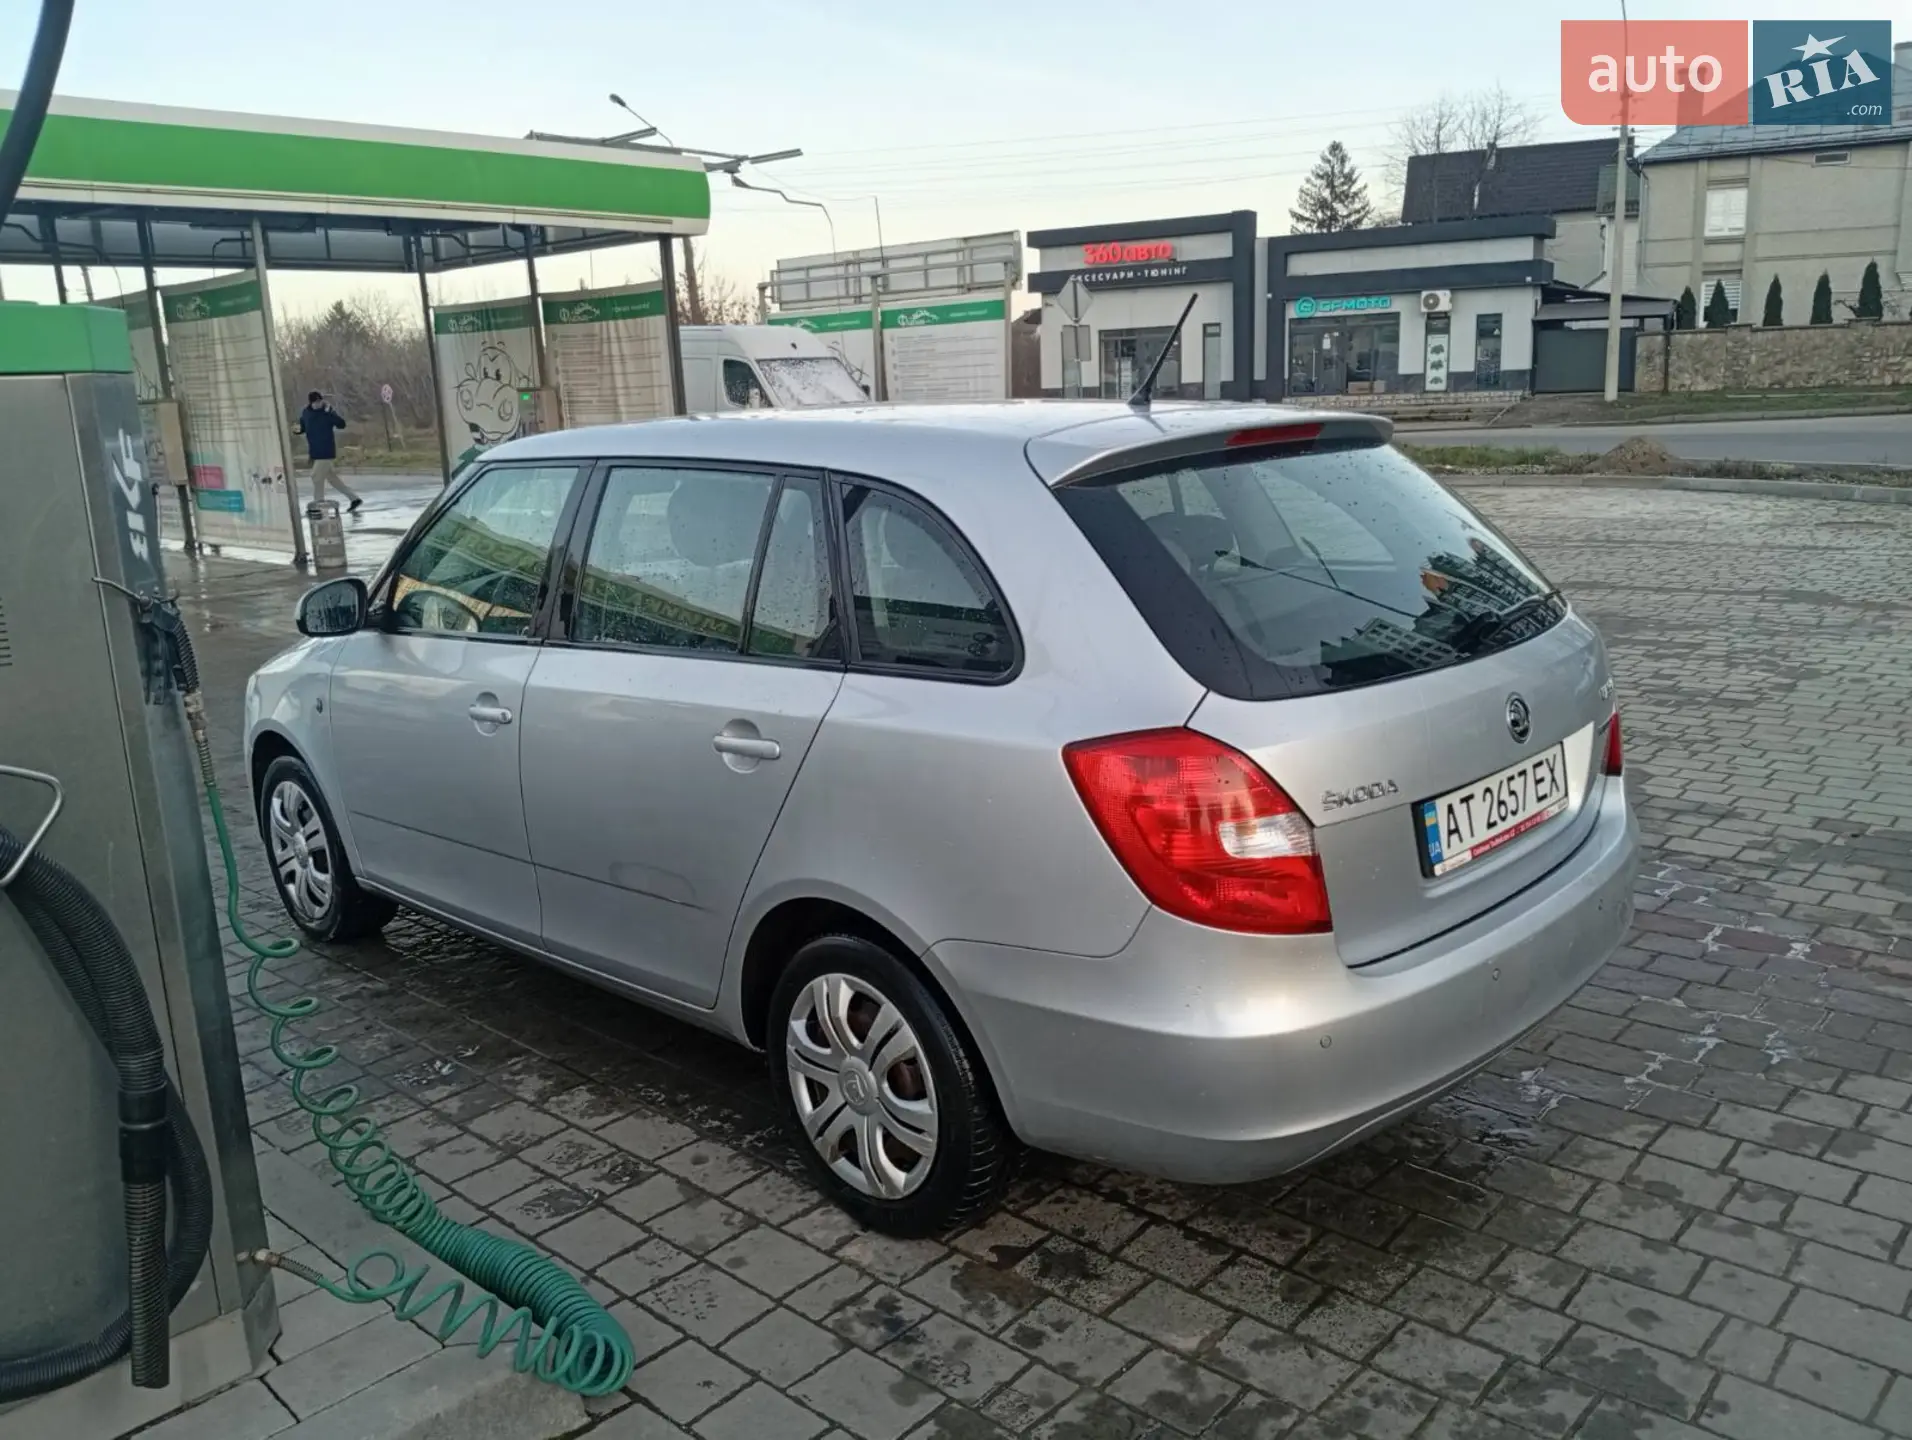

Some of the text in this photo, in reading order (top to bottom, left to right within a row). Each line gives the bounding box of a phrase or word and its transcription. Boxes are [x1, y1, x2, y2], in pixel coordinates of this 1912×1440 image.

[1144, 266, 1187, 278] ТЮНІНГ
[1447, 793, 1475, 849] AT
[1482, 768, 1528, 830] 2657
[1532, 753, 1560, 803] EX
[1428, 841, 1442, 857] UA
